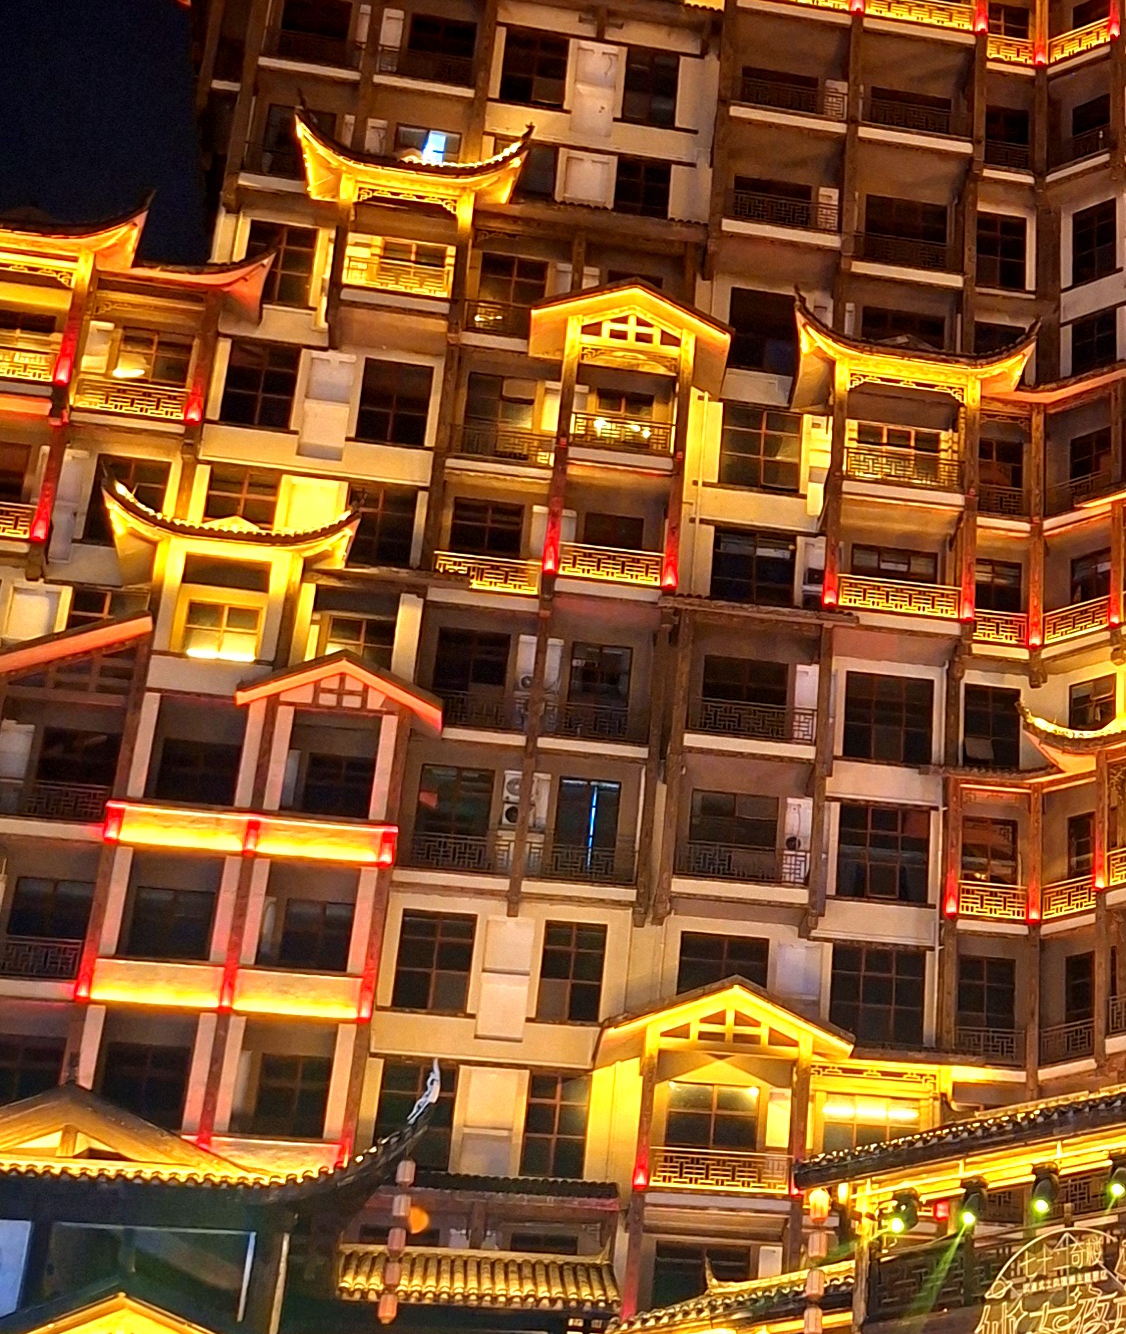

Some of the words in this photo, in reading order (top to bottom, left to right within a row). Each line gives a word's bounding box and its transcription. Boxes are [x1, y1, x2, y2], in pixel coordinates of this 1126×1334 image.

[1019, 1235, 1104, 1277] 七十二奇楼
